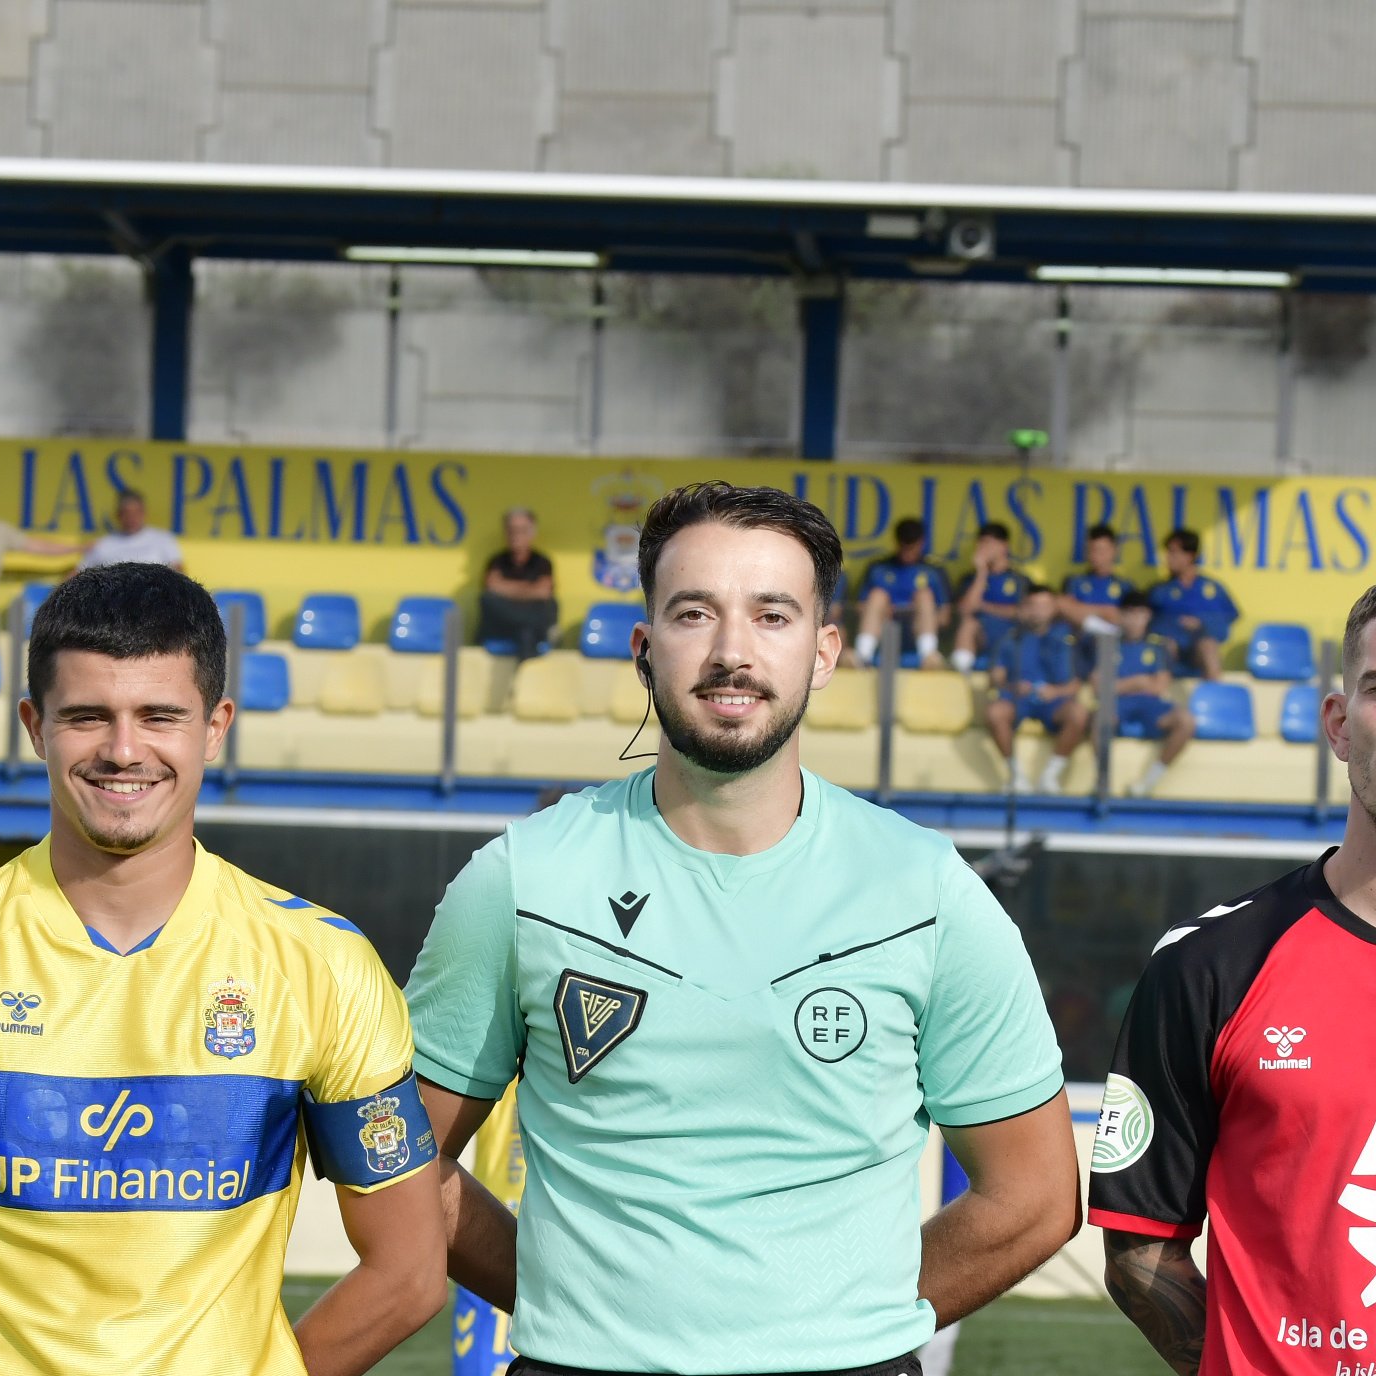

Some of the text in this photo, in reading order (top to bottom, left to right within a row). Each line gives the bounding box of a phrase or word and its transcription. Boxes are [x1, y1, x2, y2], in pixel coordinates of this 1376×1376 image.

[18, 448, 144, 534] LAS
[170, 454, 468, 546] PALMAS
[921, 477, 1043, 562] LAS
[1071, 482, 1372, 573] PALMAS
[576, 1046, 590, 1058] CTA
[1259, 1056, 1312, 1070] hummel
[53, 1158, 250, 1201] Financial
[1276, 1316, 1323, 1349] Isla
[1329, 1319, 1368, 1351] de
